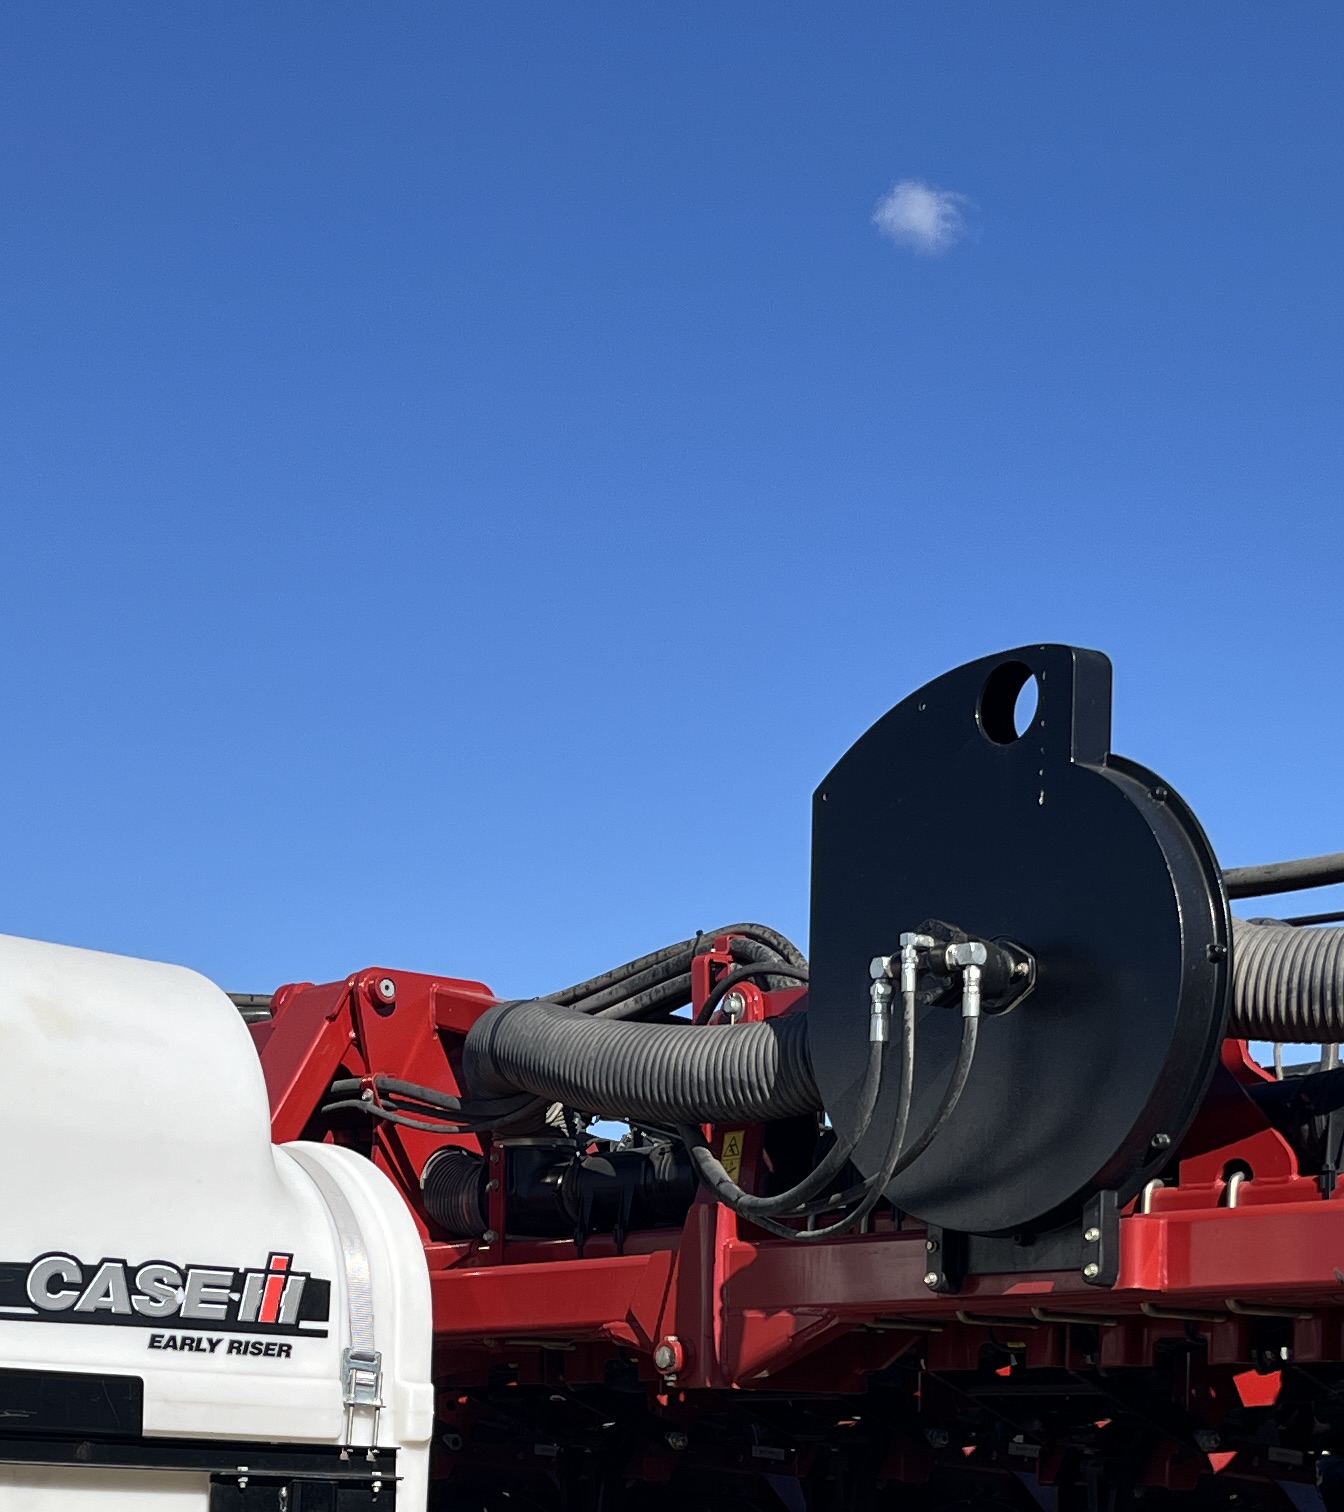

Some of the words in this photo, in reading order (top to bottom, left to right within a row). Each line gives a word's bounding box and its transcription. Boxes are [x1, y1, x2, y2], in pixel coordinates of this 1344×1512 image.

[26, 1255, 236, 1320] CASE
[147, 1333, 223, 1354] EARLY
[226, 1339, 293, 1359] RISER
